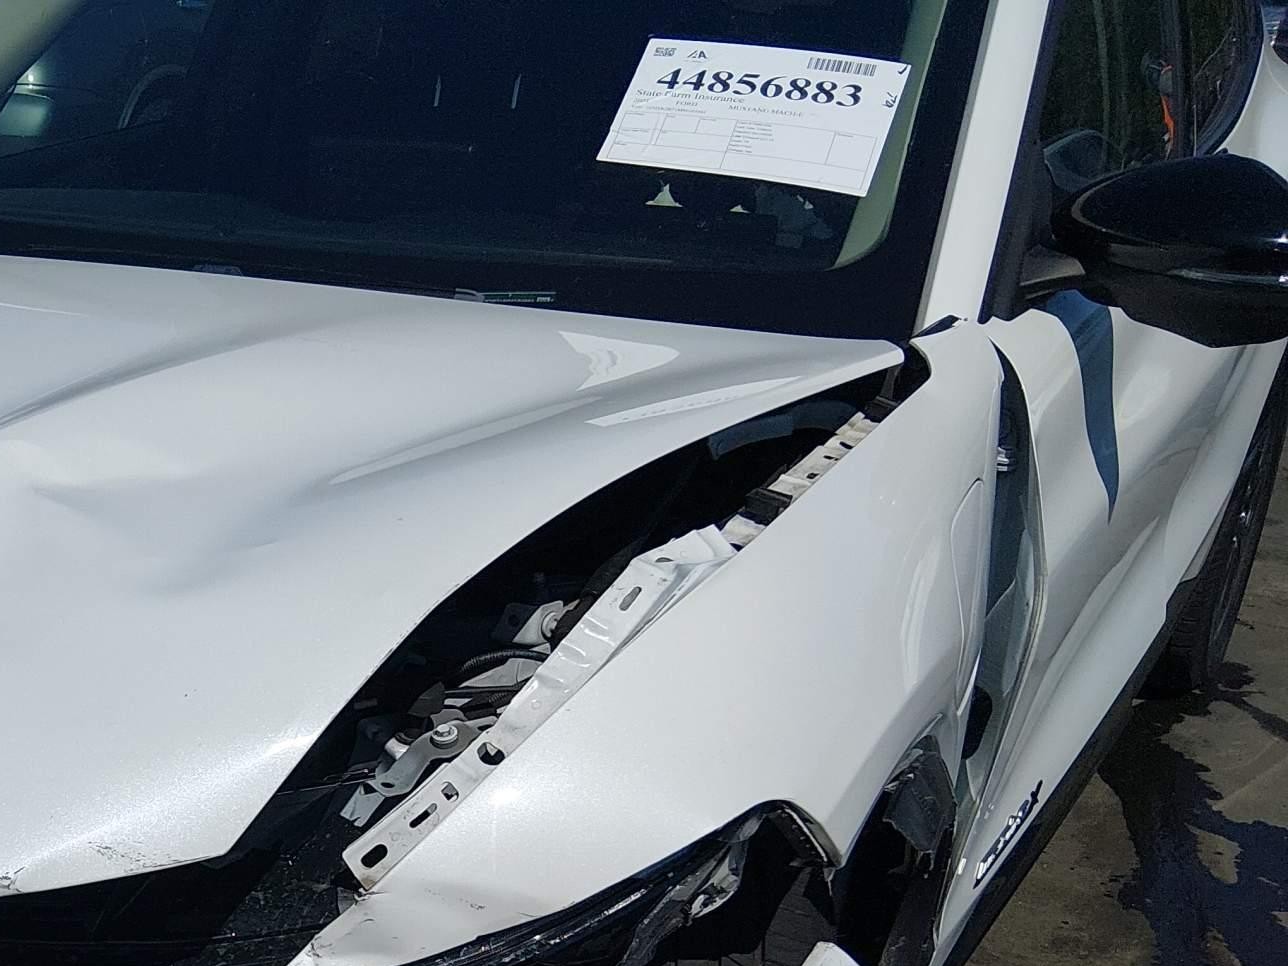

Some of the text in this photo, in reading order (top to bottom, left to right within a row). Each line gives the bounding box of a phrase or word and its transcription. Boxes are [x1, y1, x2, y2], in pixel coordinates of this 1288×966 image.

[636, 88, 745, 103] State Farm Insurance
[656, 68, 862, 107] 44856883
